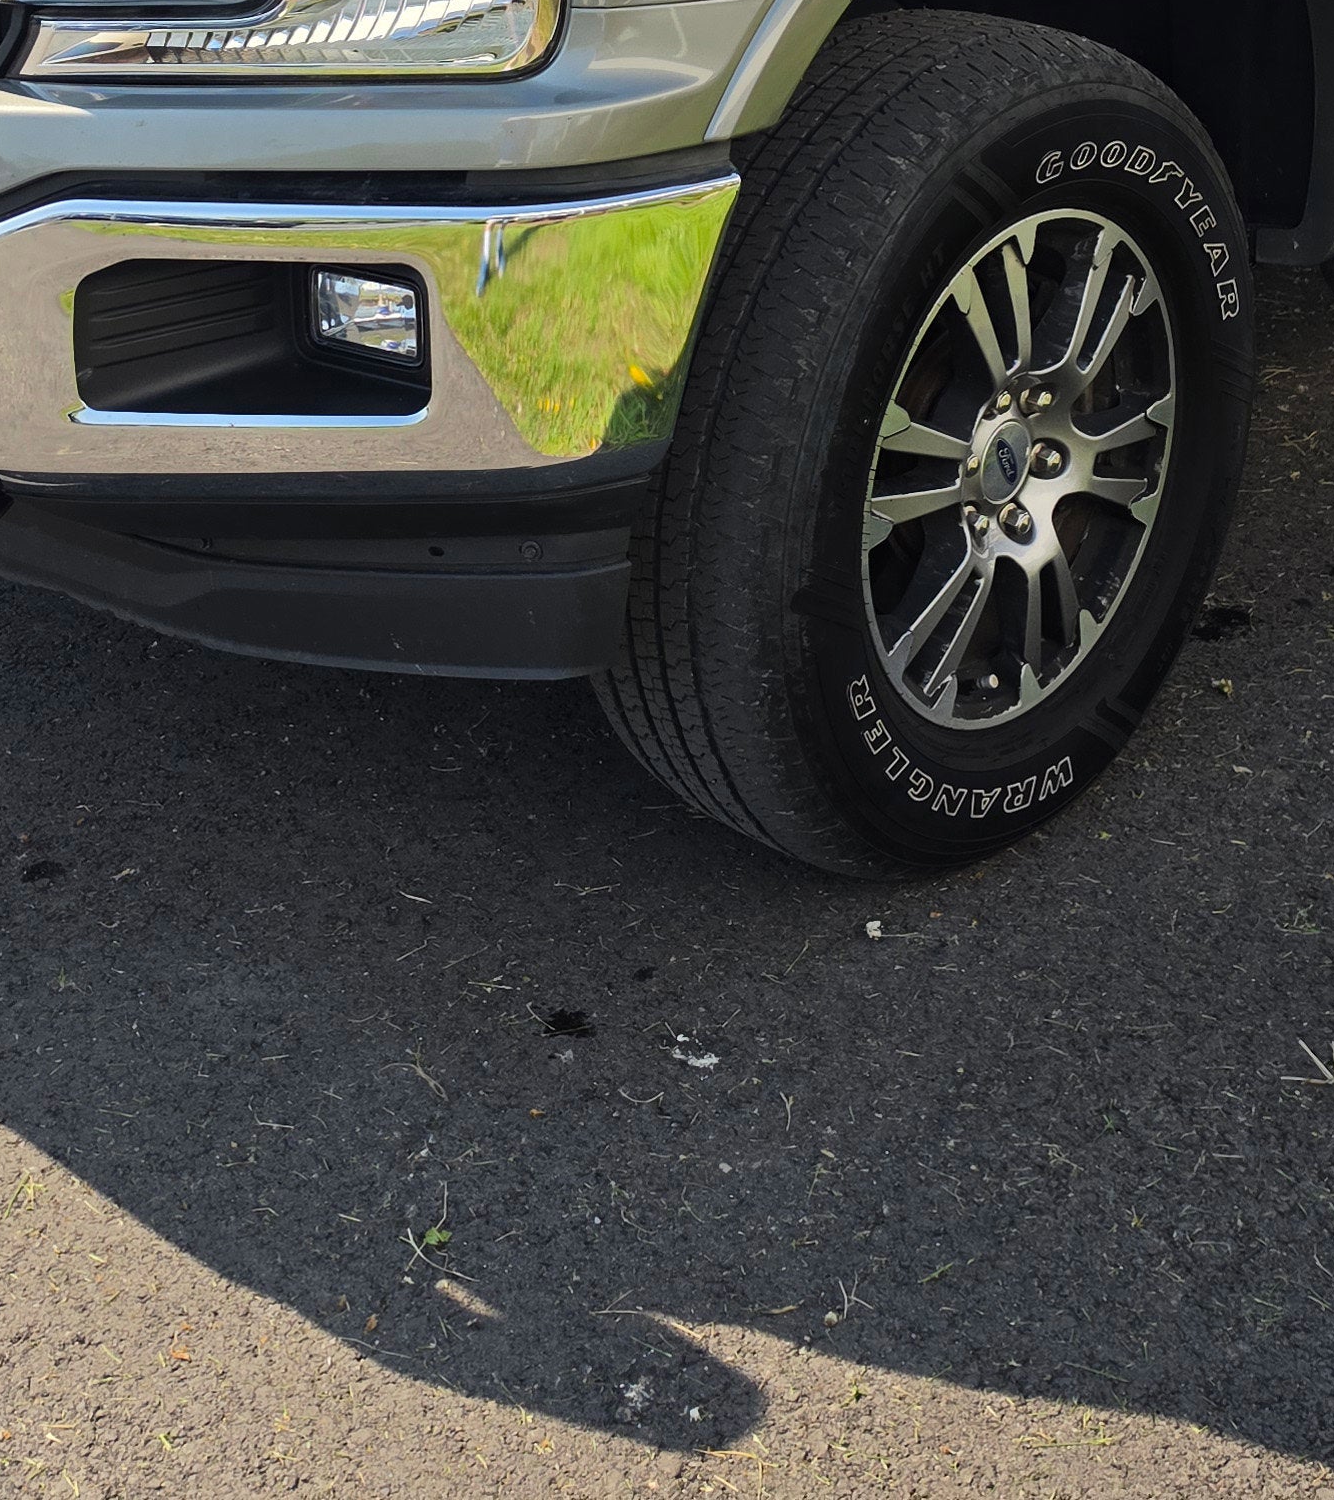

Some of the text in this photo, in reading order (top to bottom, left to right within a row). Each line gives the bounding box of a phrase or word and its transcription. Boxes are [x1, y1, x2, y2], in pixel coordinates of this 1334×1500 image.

[1035, 140, 1241, 321] GOODYEAR
[998, 447, 1015, 477] Ford
[847, 674, 1074, 819] WRANGLER
